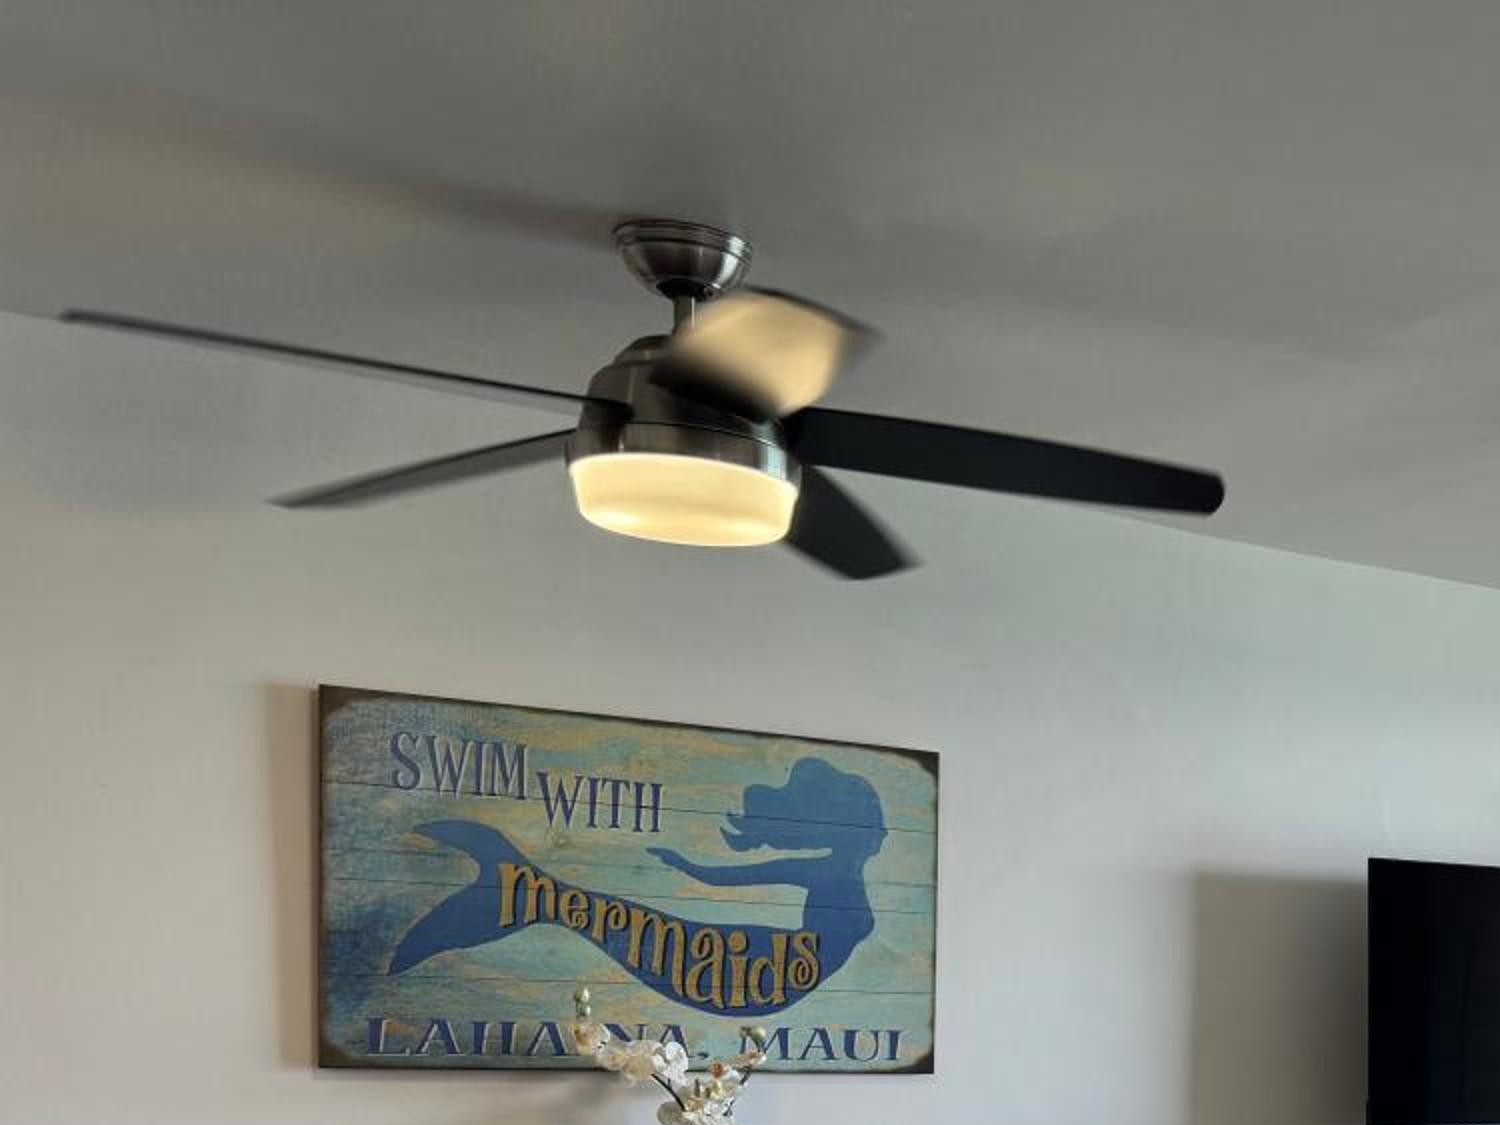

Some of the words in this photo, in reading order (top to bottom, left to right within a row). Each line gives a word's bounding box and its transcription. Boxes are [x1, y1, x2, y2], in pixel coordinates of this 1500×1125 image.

[389, 731, 528, 800] SWIM
[536, 771, 664, 833] WITH
[499, 863, 820, 1009] mermaids
[366, 1016, 708, 1058] LAHANA,
[739, 1026, 904, 1062] MAUI
